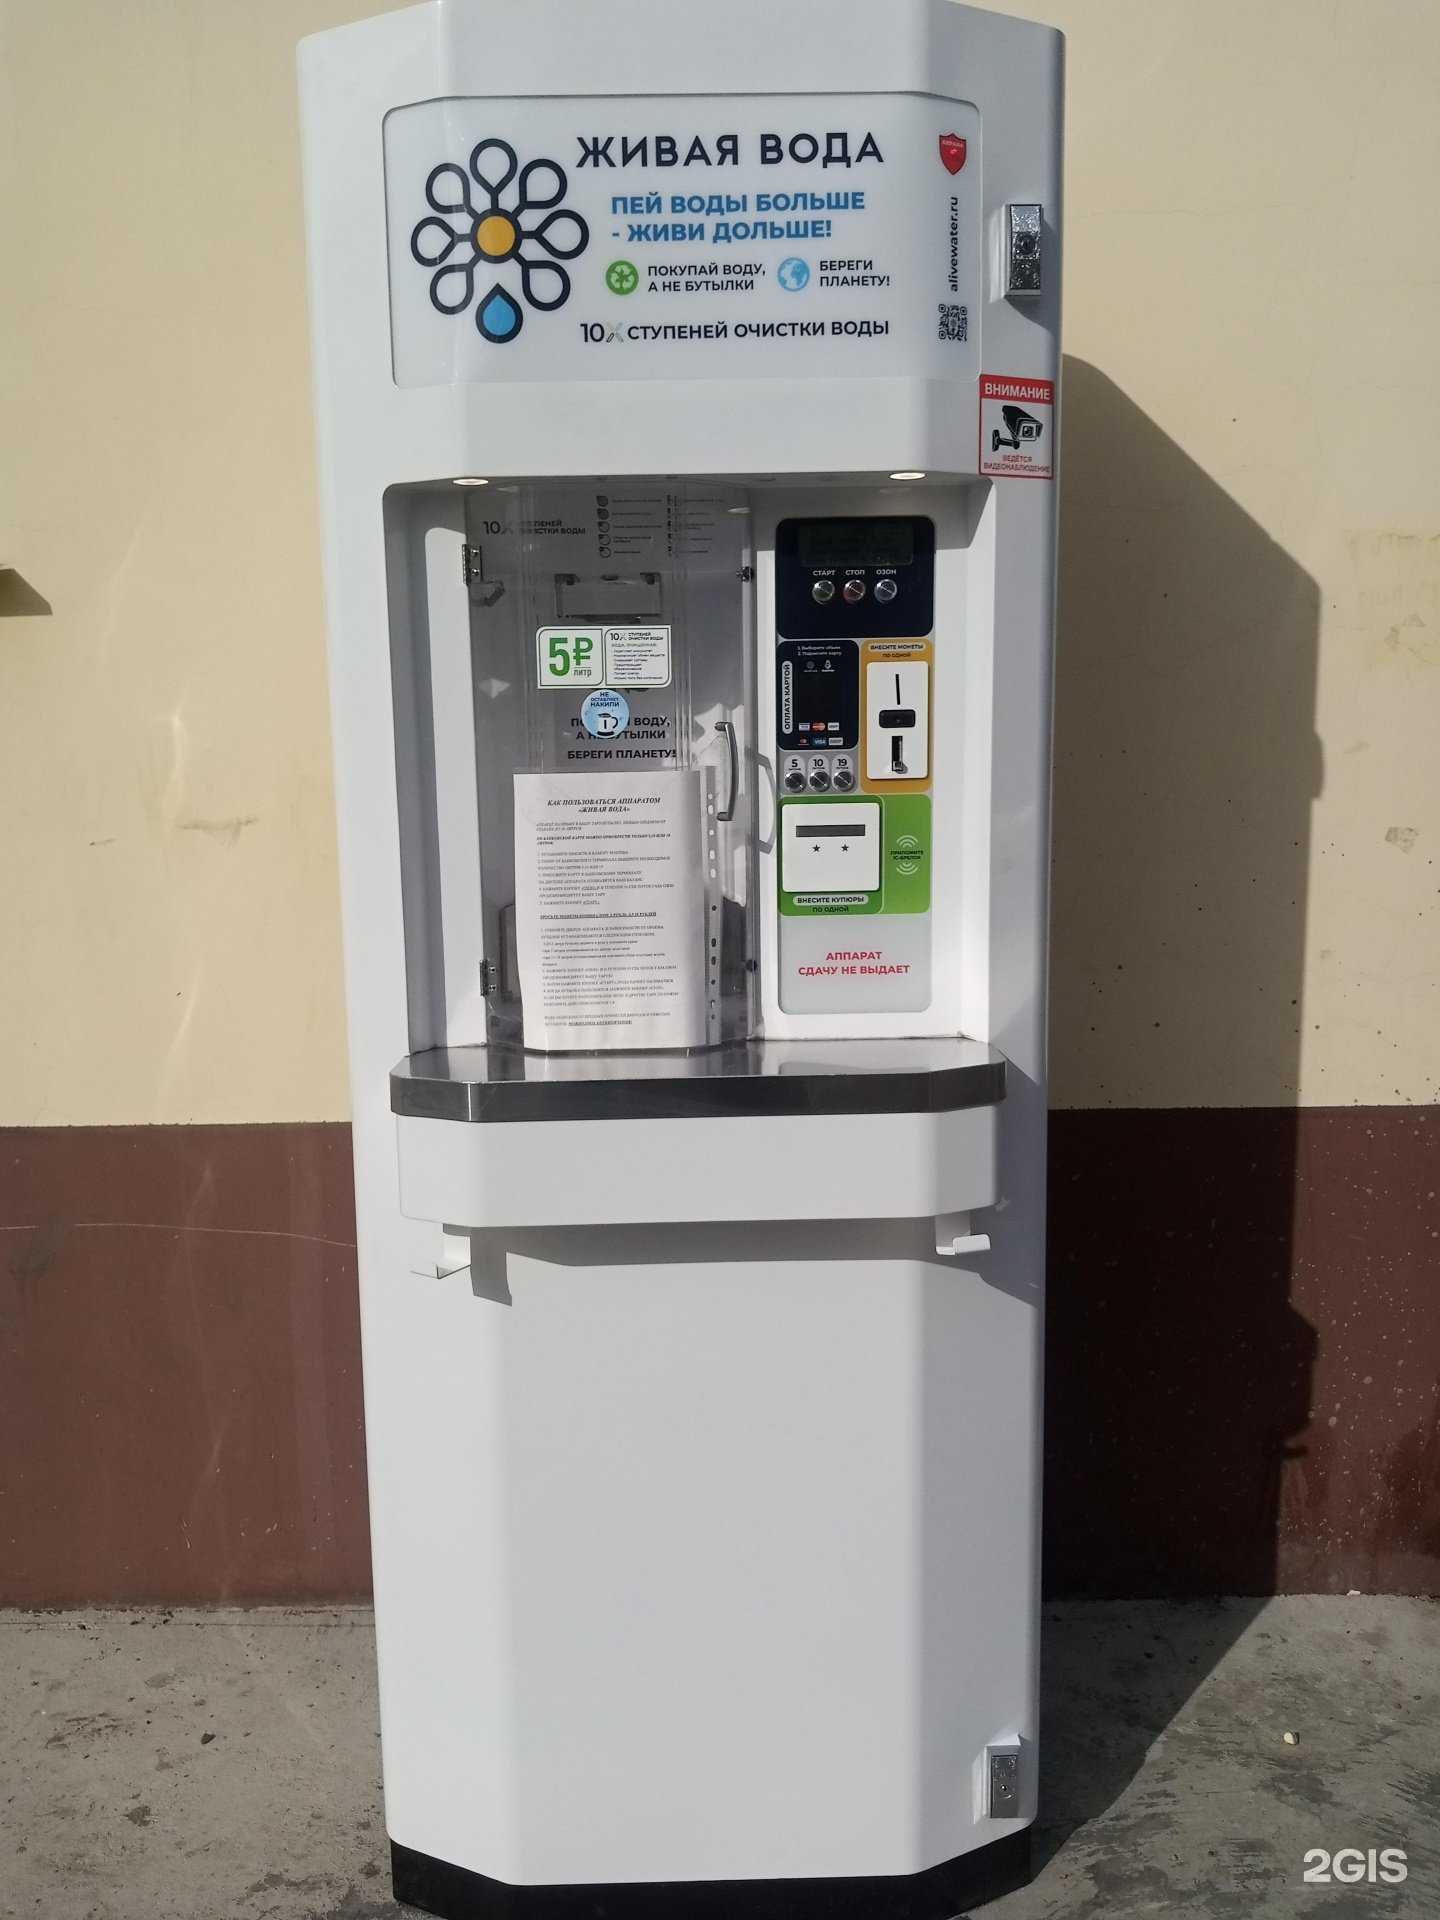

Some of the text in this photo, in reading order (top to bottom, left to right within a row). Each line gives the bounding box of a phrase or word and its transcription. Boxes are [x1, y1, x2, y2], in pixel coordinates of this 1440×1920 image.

[575, 132, 884, 168] ЖИВАЯ ВОДА
[611, 191, 865, 216] ПЕЙ ВОДЫ БОЛЬШЕ
[627, 222, 705, 243] ЖИВИ
[712, 219, 832, 244] ДОЛЬШЕ!
[947, 196, 959, 293] alivewater.ru
[648, 262, 766, 277] ПОКУПАЙ ВОДУ,
[819, 260, 873, 272] БЕРЕГИ
[648, 280, 755, 292] А НЕ БУТЫЛКИ
[819, 275, 890, 288] ПЛАНЕТУ!
[627, 320, 728, 340] СТУПЕНЕЙ
[734, 322, 825, 338] ОЧИСТКИ
[831, 320, 889, 338] ВОДЫ
[984, 383, 1050, 400] ВНИМАНИЕ
[876, 568, 897, 576] ОЗОН
[784, 664, 792, 730] ОПЛАТА КАРТОЙ
[634, 716, 671, 728] ВОДУ,
[576, 731, 586, 740] А
[567, 749, 677, 760] БЕРЕГИ ПЛАНЕТУ!
[791, 758, 798, 768] 5
[813, 758, 824, 767] 10
[837, 758, 848, 767] 19
[797, 896, 865, 904] ВНЕСИТЕ КУПЮРЫ
[826, 905, 849, 913] ОДНОЙ
[826, 952, 883, 961] АППАРАТ
[798, 964, 911, 977] СДАЧУ НЕ ВЫДАЕТ
